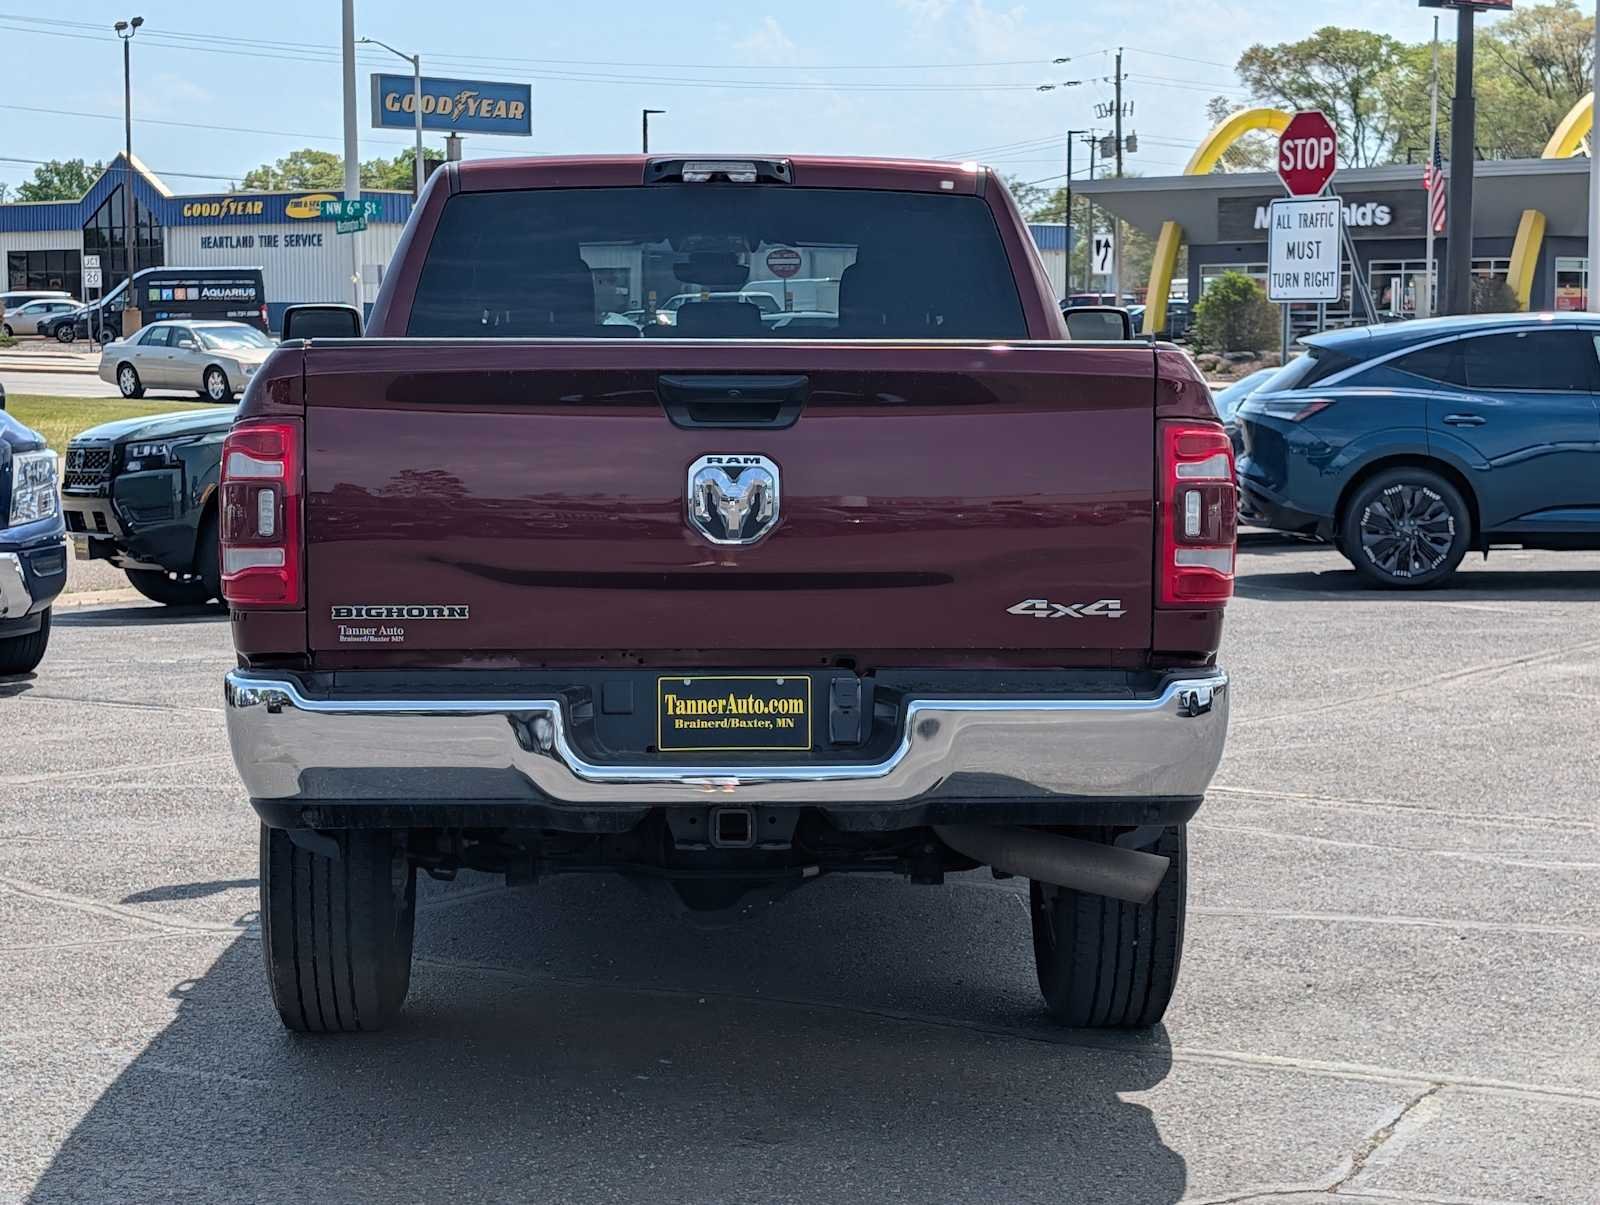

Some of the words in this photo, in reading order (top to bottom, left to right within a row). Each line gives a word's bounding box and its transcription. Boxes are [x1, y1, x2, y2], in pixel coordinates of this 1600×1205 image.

[385, 91, 525, 121] GOODYEAR
[1281, 137, 1334, 172] STOP
[183, 198, 263, 218] GOODYEAR
[326, 202, 342, 215] NW
[364, 201, 377, 215] St
[1276, 214, 1292, 230] ALL
[1298, 211, 1335, 229] TRAFFIC
[200, 235, 254, 249] HEARTLAND
[258, 234, 279, 248] TIRE
[283, 233, 323, 248] SERVICE
[1286, 240, 1322, 261] MUST
[87, 271, 98, 283] 20
[1272, 272, 1300, 289] TURN
[1303, 271, 1336, 288] RIGHT
[201, 287, 256, 297] AQUARIUS
[331, 605, 469, 619] BIGHORN
[1006, 599, 1128, 618] 4x4
[338, 624, 378, 636] Tanner
[379, 625, 404, 636] Auto
[664, 693, 805, 715] TannerAuto.com
[674, 717, 773, 730] Brainerd/Baxter,
[775, 718, 795, 729] MN
